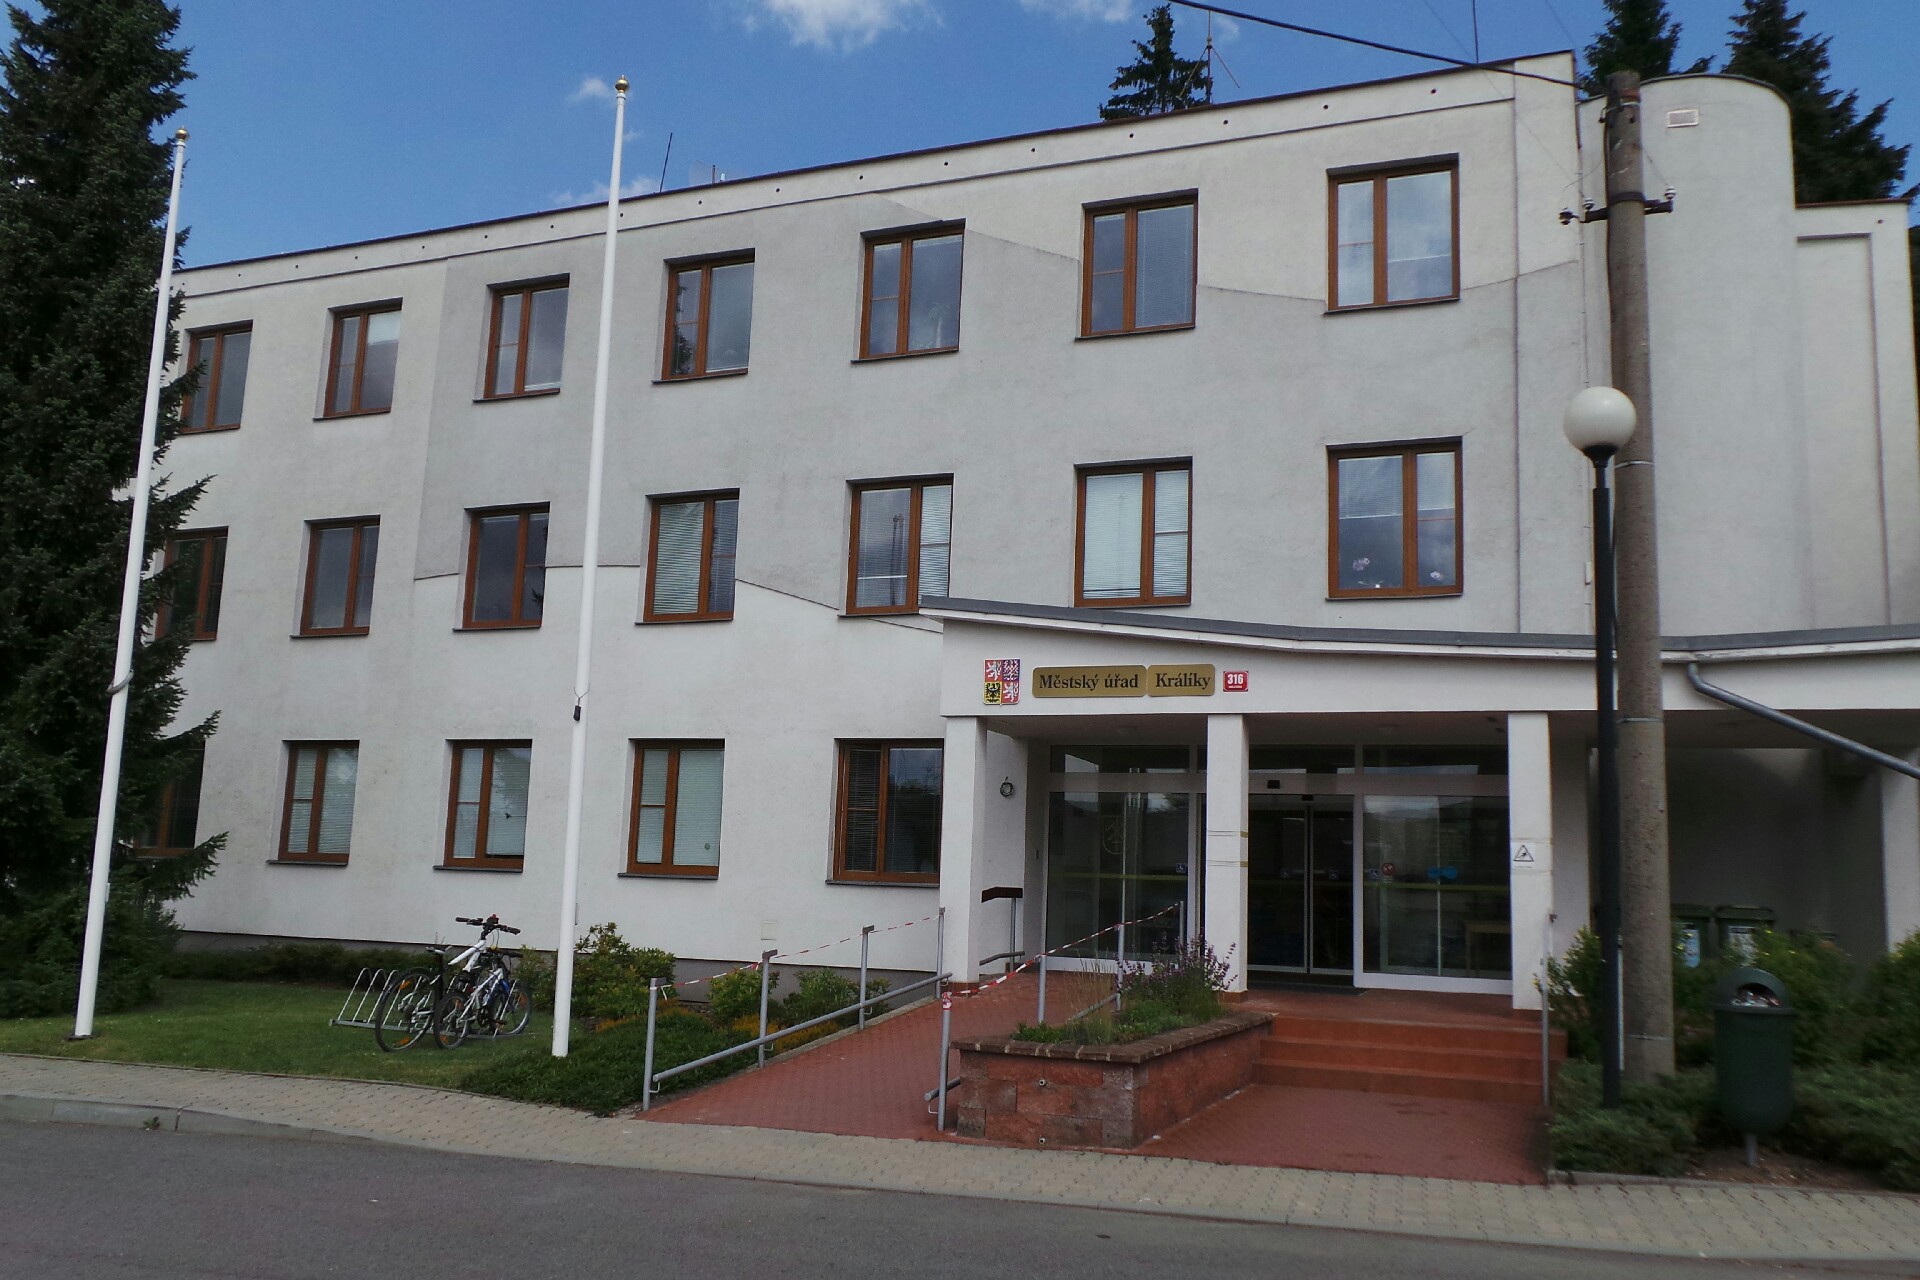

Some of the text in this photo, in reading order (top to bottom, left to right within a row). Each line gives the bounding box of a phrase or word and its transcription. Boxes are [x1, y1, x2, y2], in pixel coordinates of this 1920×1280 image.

[1039, 672, 1211, 691] Městský úřad Králíky
[1227, 673, 1244, 685] 316
